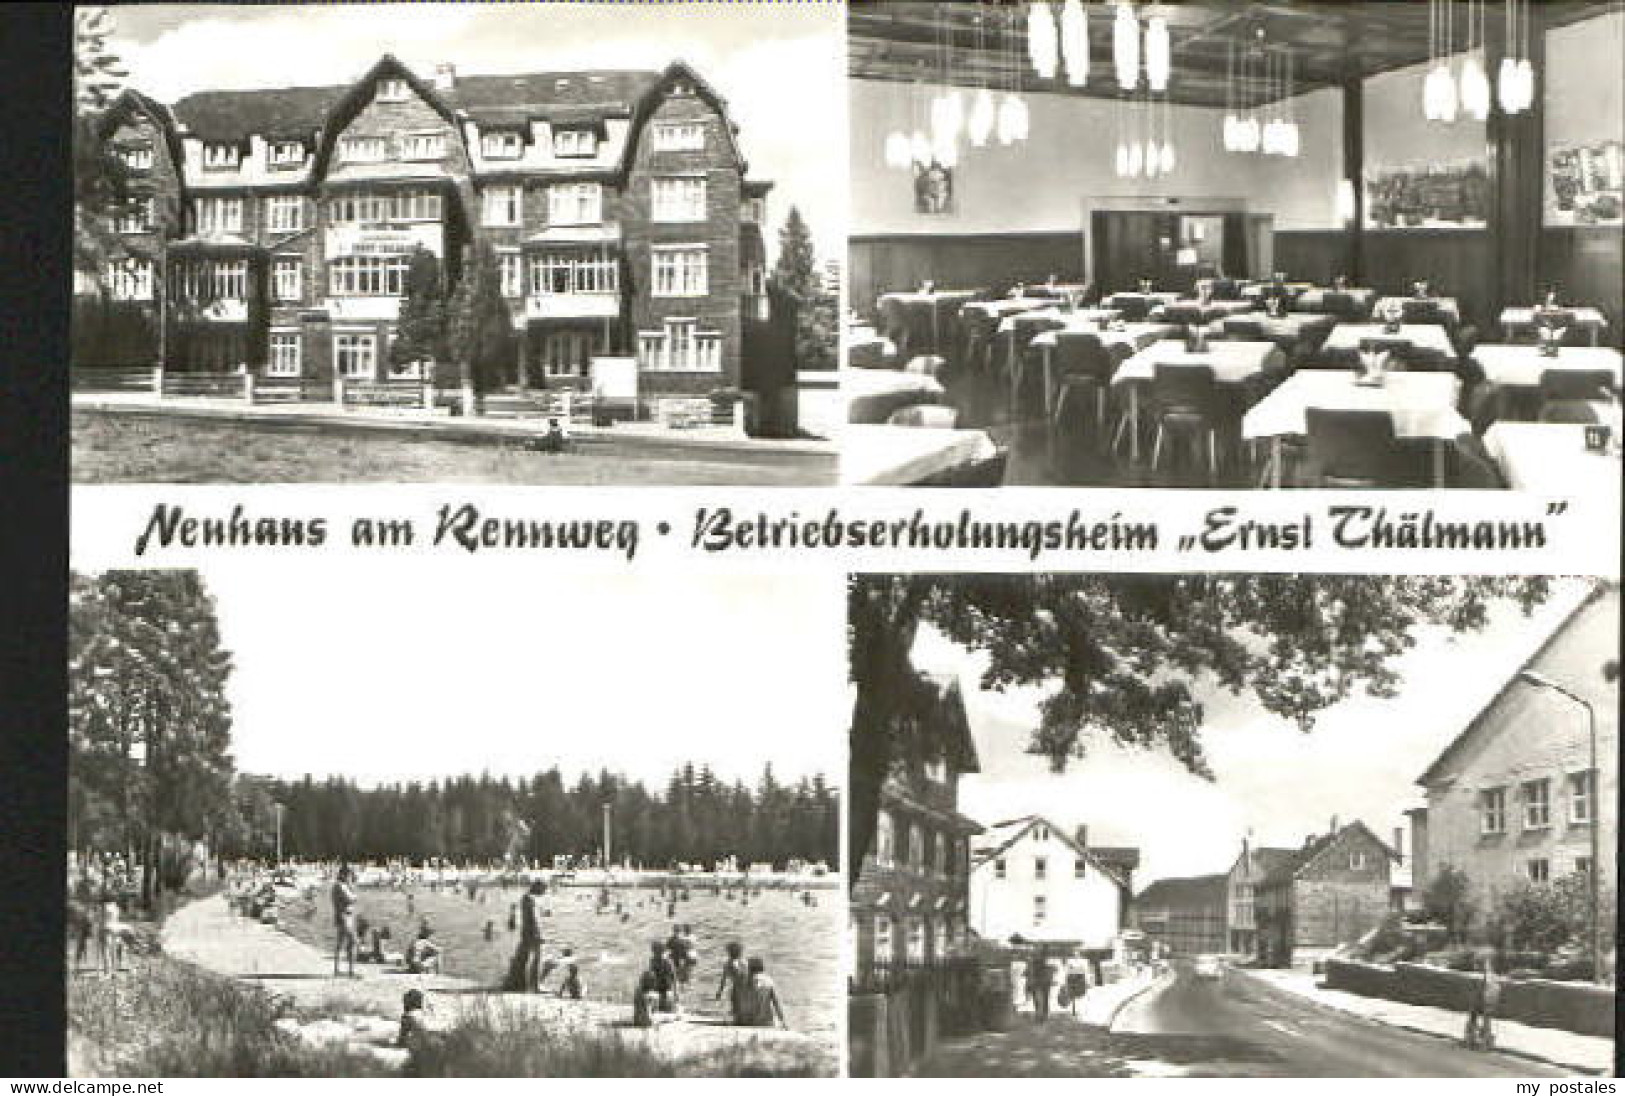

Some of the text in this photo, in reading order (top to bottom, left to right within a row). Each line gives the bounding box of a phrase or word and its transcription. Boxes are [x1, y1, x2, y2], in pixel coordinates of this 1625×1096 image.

[136, 503, 327, 556] Neuhaus
[351, 518, 414, 546] am
[433, 503, 639, 561] Rennweg
[692, 506, 1158, 561] Betriebserholungsheim
